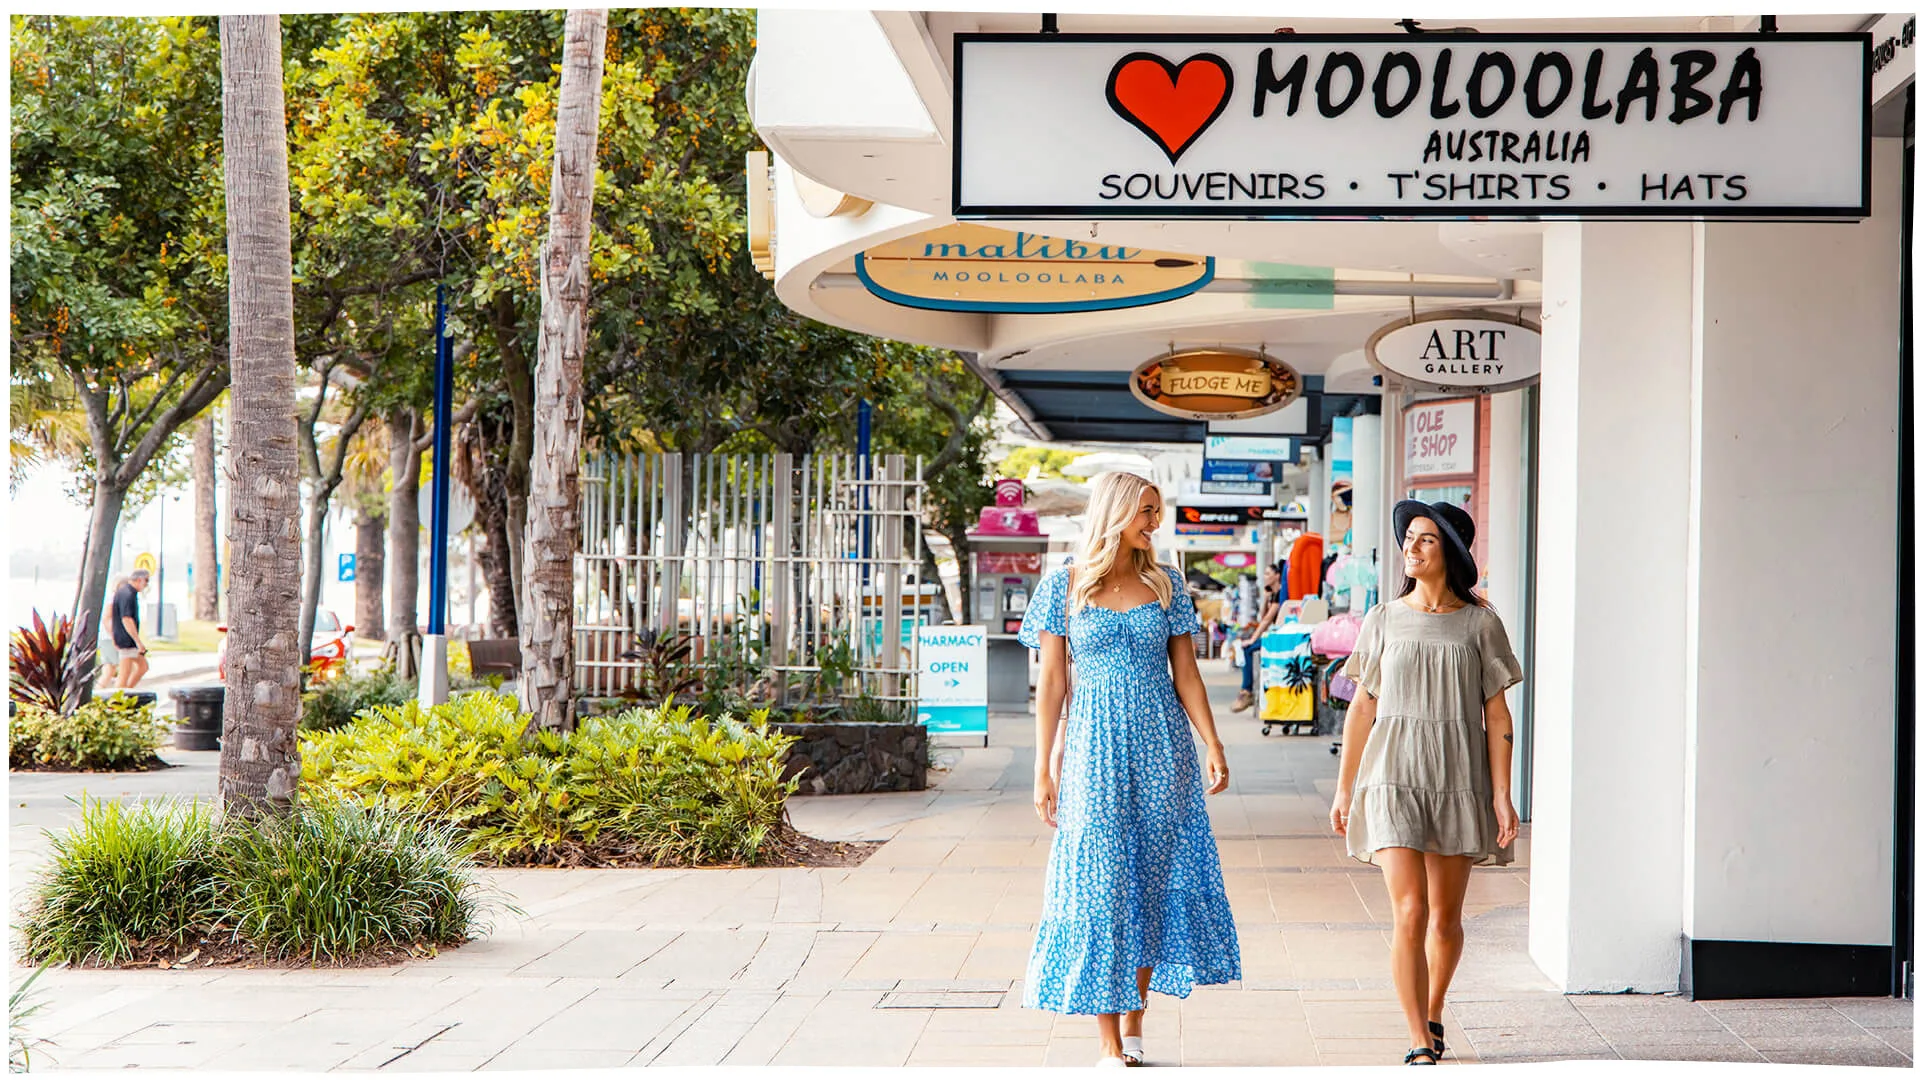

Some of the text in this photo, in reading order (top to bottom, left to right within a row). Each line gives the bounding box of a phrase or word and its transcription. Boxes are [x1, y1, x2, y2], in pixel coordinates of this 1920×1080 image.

[1253, 47, 1763, 125] MOOLOOLABA
[1423, 129, 1590, 163] AUSTRALIA
[1099, 169, 1748, 201] SOUVENIRS T'SHIRTS HATS
[923, 231, 1142, 260] malibu
[933, 271, 1124, 284] MOOLOOLABA
[1419, 328, 1506, 361] ART
[1425, 363, 1504, 375] GALLERY
[1169, 376, 1263, 393] FUDGE ME
[1420, 433, 1457, 458] SHOP
[918, 635, 983, 647] PHARMACY
[930, 662, 969, 673] OPEN
